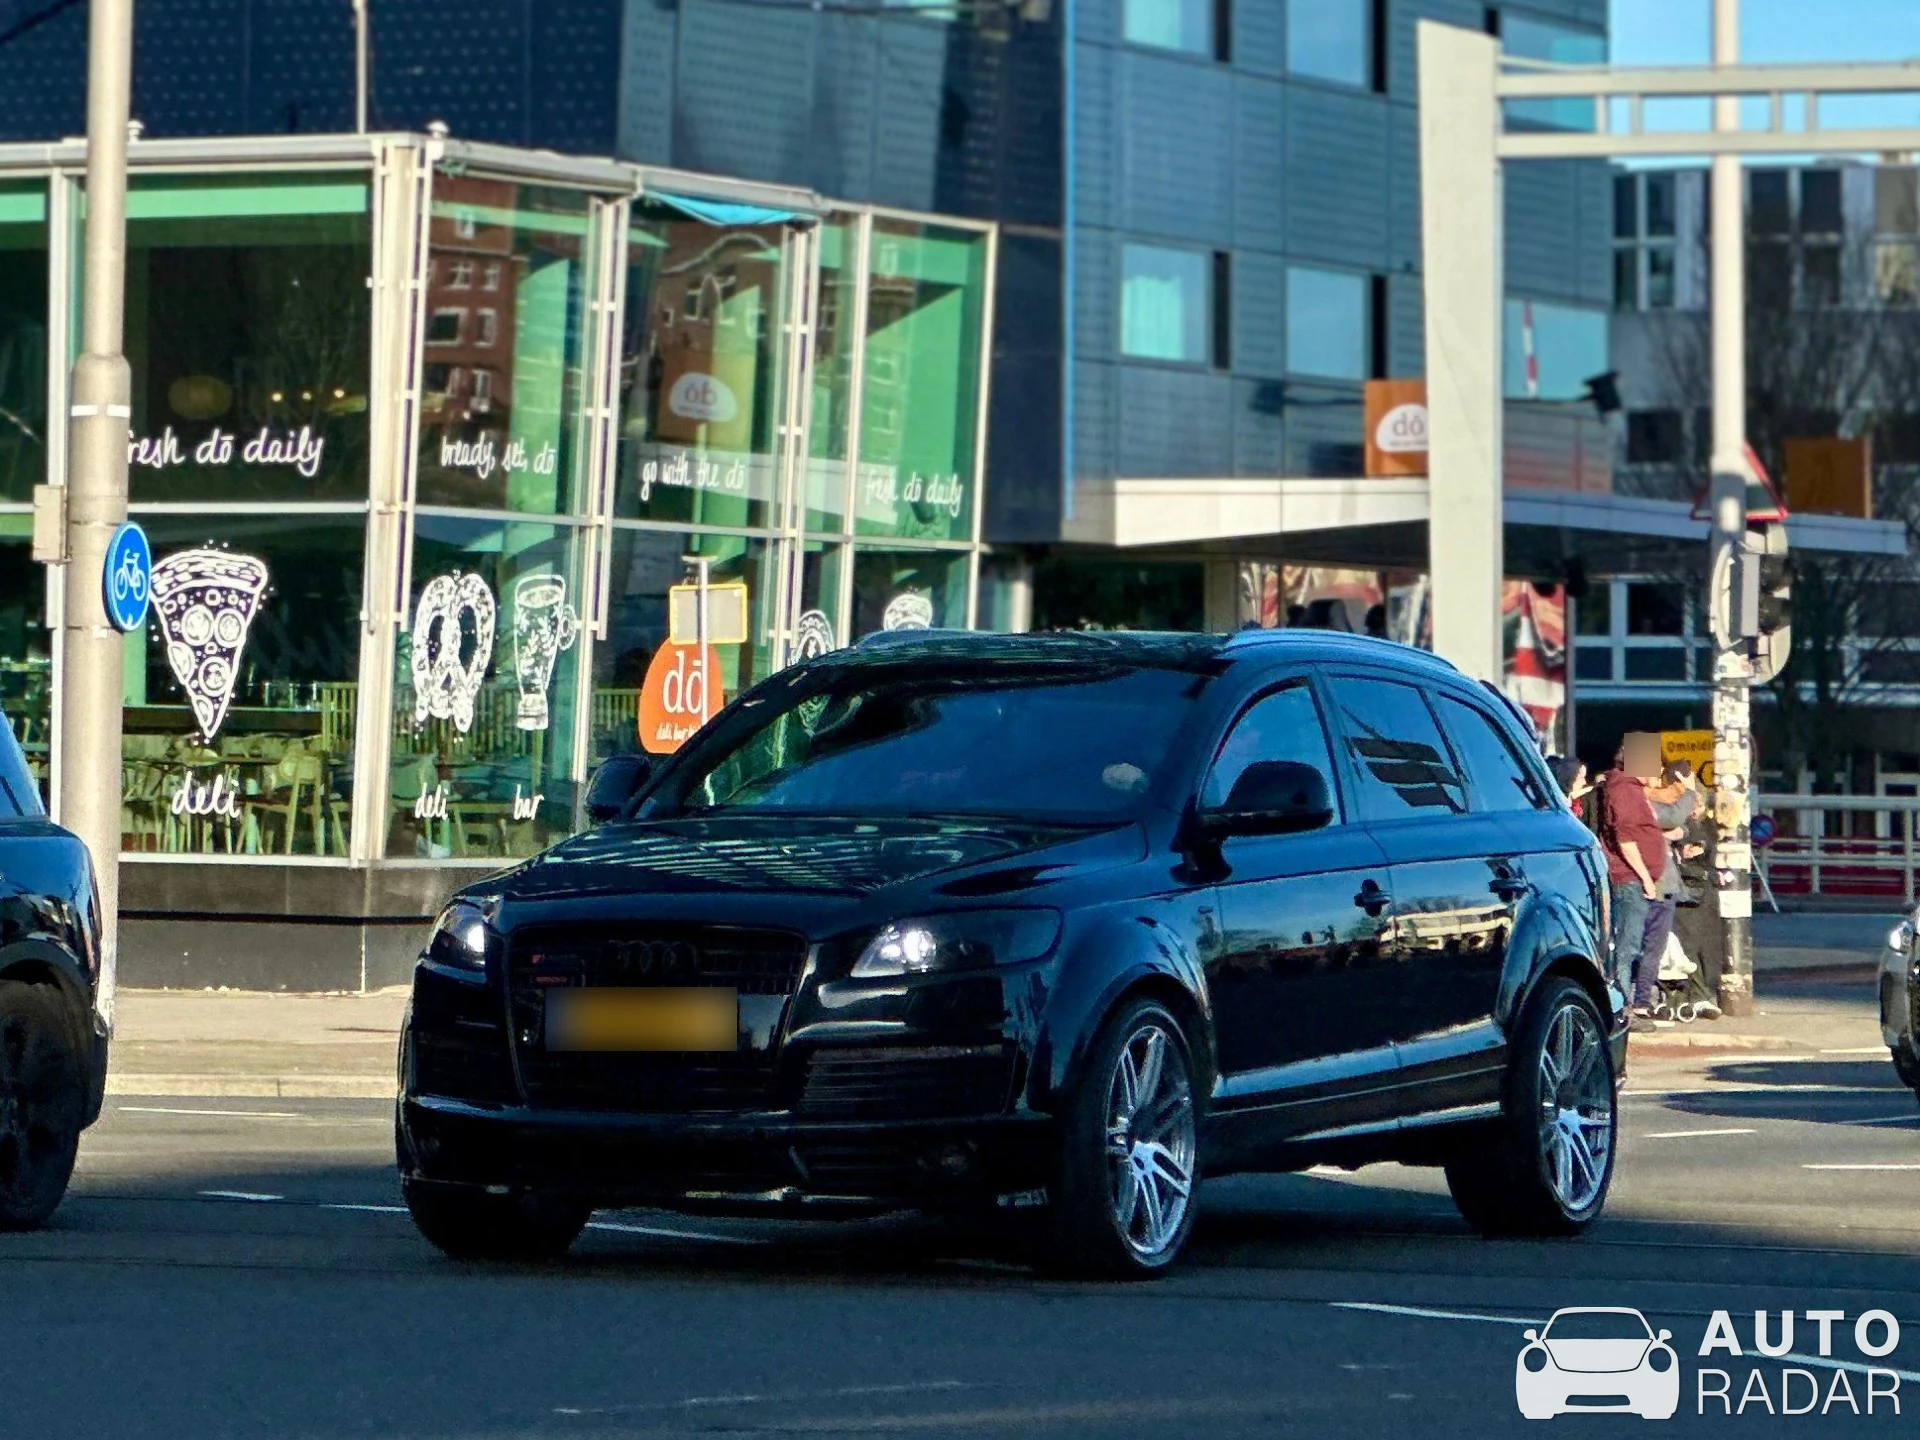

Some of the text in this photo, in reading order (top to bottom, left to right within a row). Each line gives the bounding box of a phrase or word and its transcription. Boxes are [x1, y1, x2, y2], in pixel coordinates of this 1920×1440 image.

[128, 425, 324, 477] resh dō daily
[641, 460, 658, 502] go
[662, 450, 692, 486] with
[696, 453, 720, 488] the
[925, 472, 963, 518] daily
[171, 770, 241, 819] deli
[414, 781, 449, 821] deli
[513, 783, 545, 821] bar
